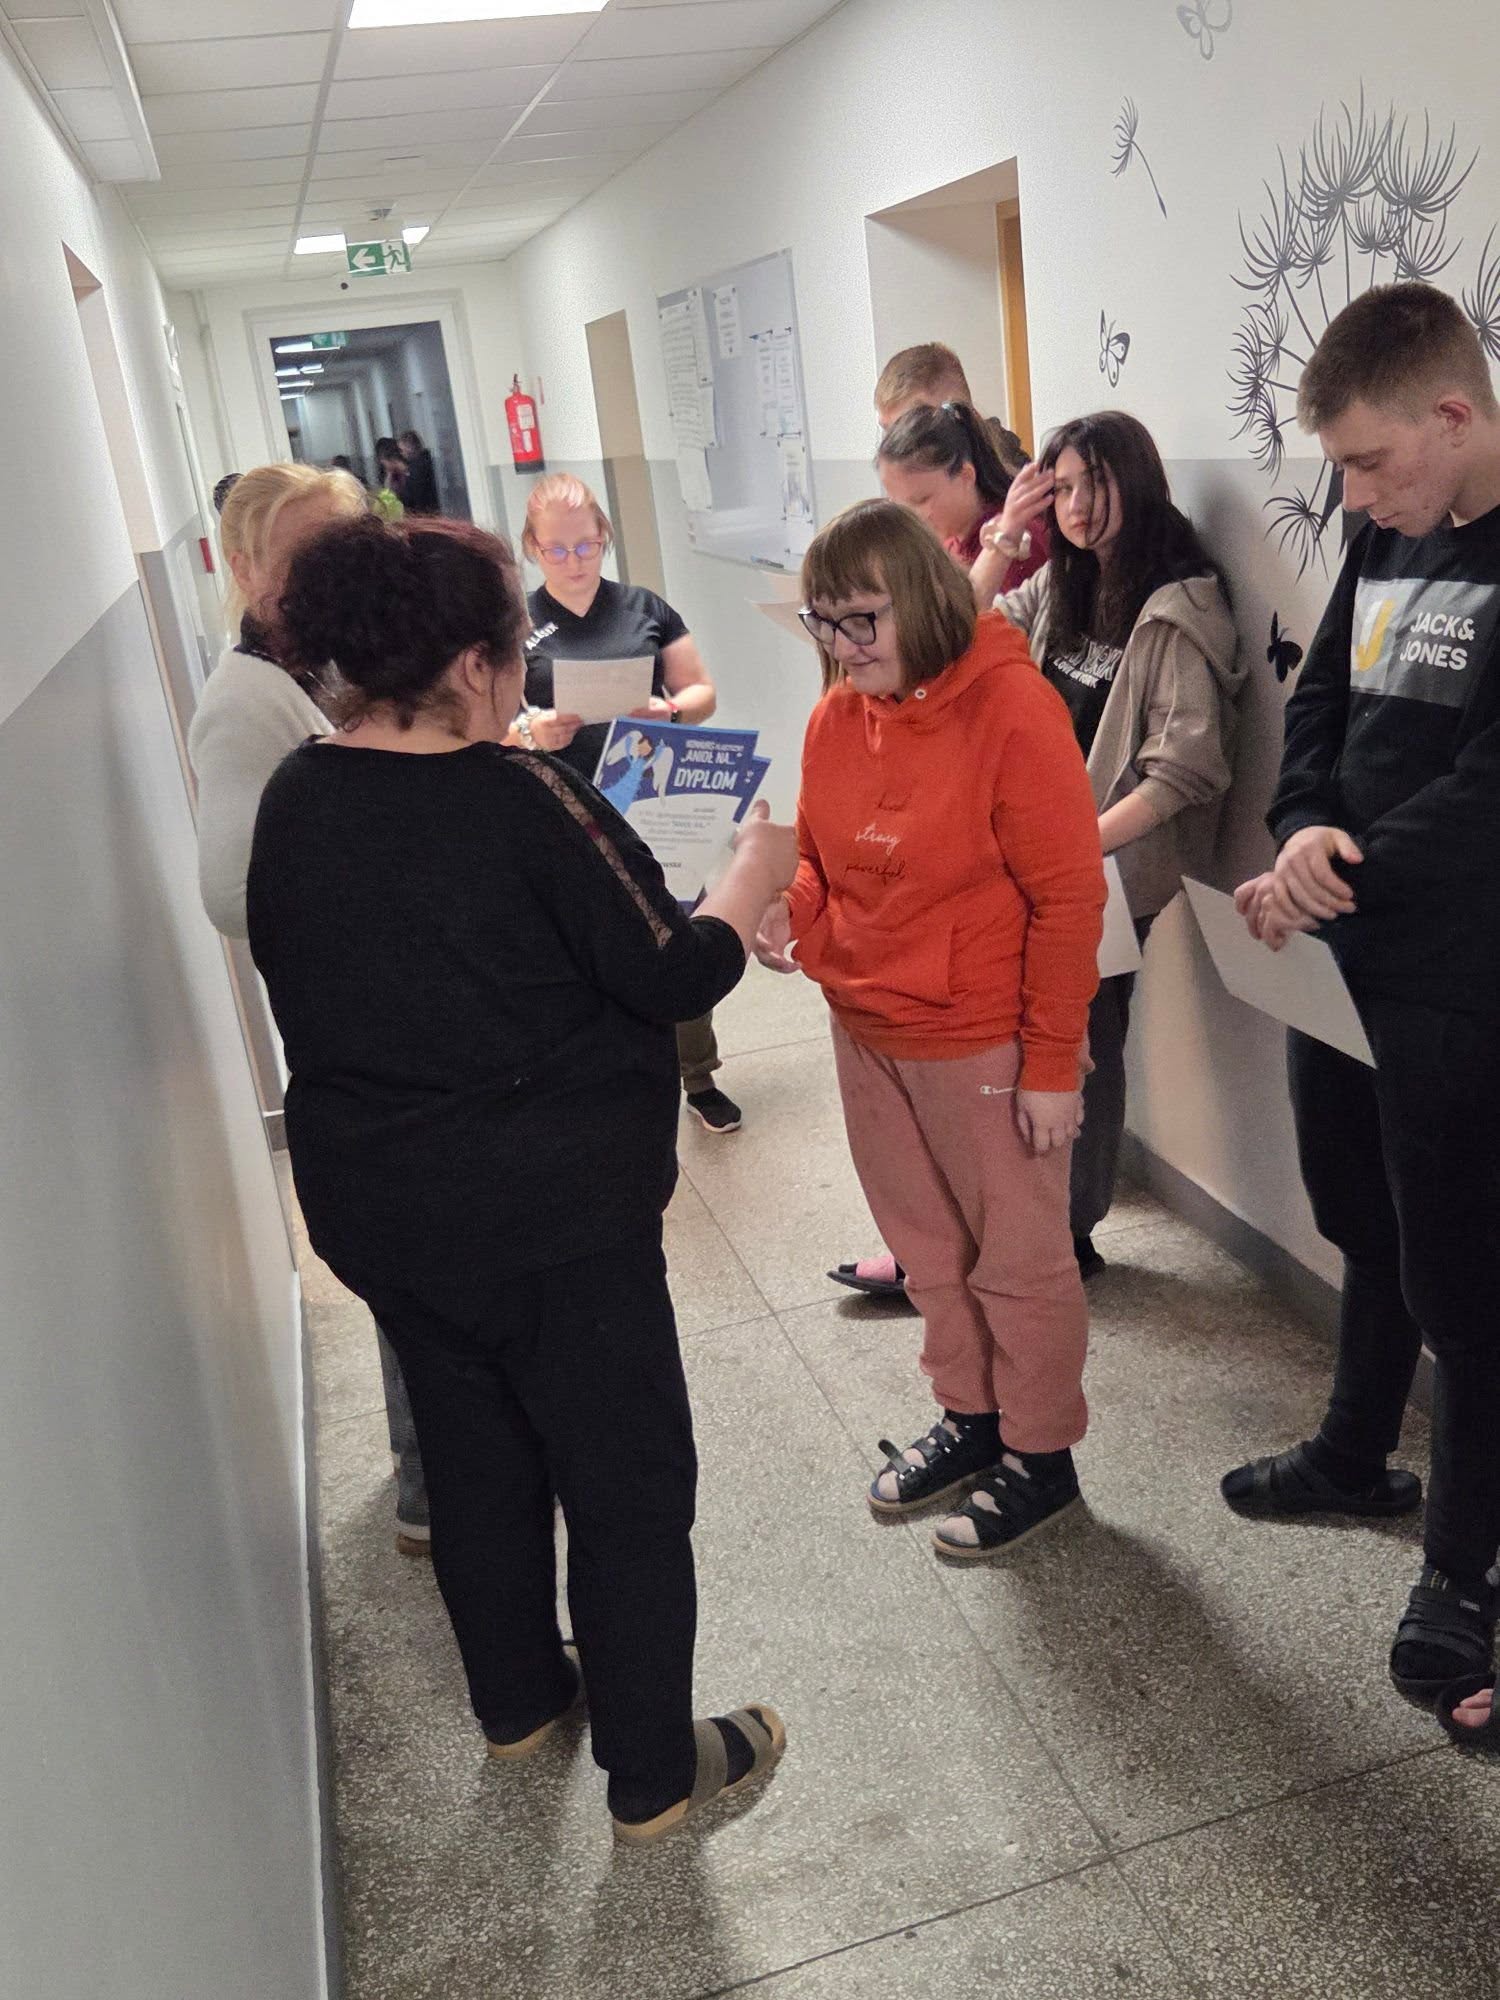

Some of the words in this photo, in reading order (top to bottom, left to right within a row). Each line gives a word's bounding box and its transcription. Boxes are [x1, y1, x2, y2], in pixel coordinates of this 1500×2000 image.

[1410, 611, 1476, 641] JACK&
[1400, 640, 1468, 671] JONES
[673, 767, 738, 790] DYPLOM
